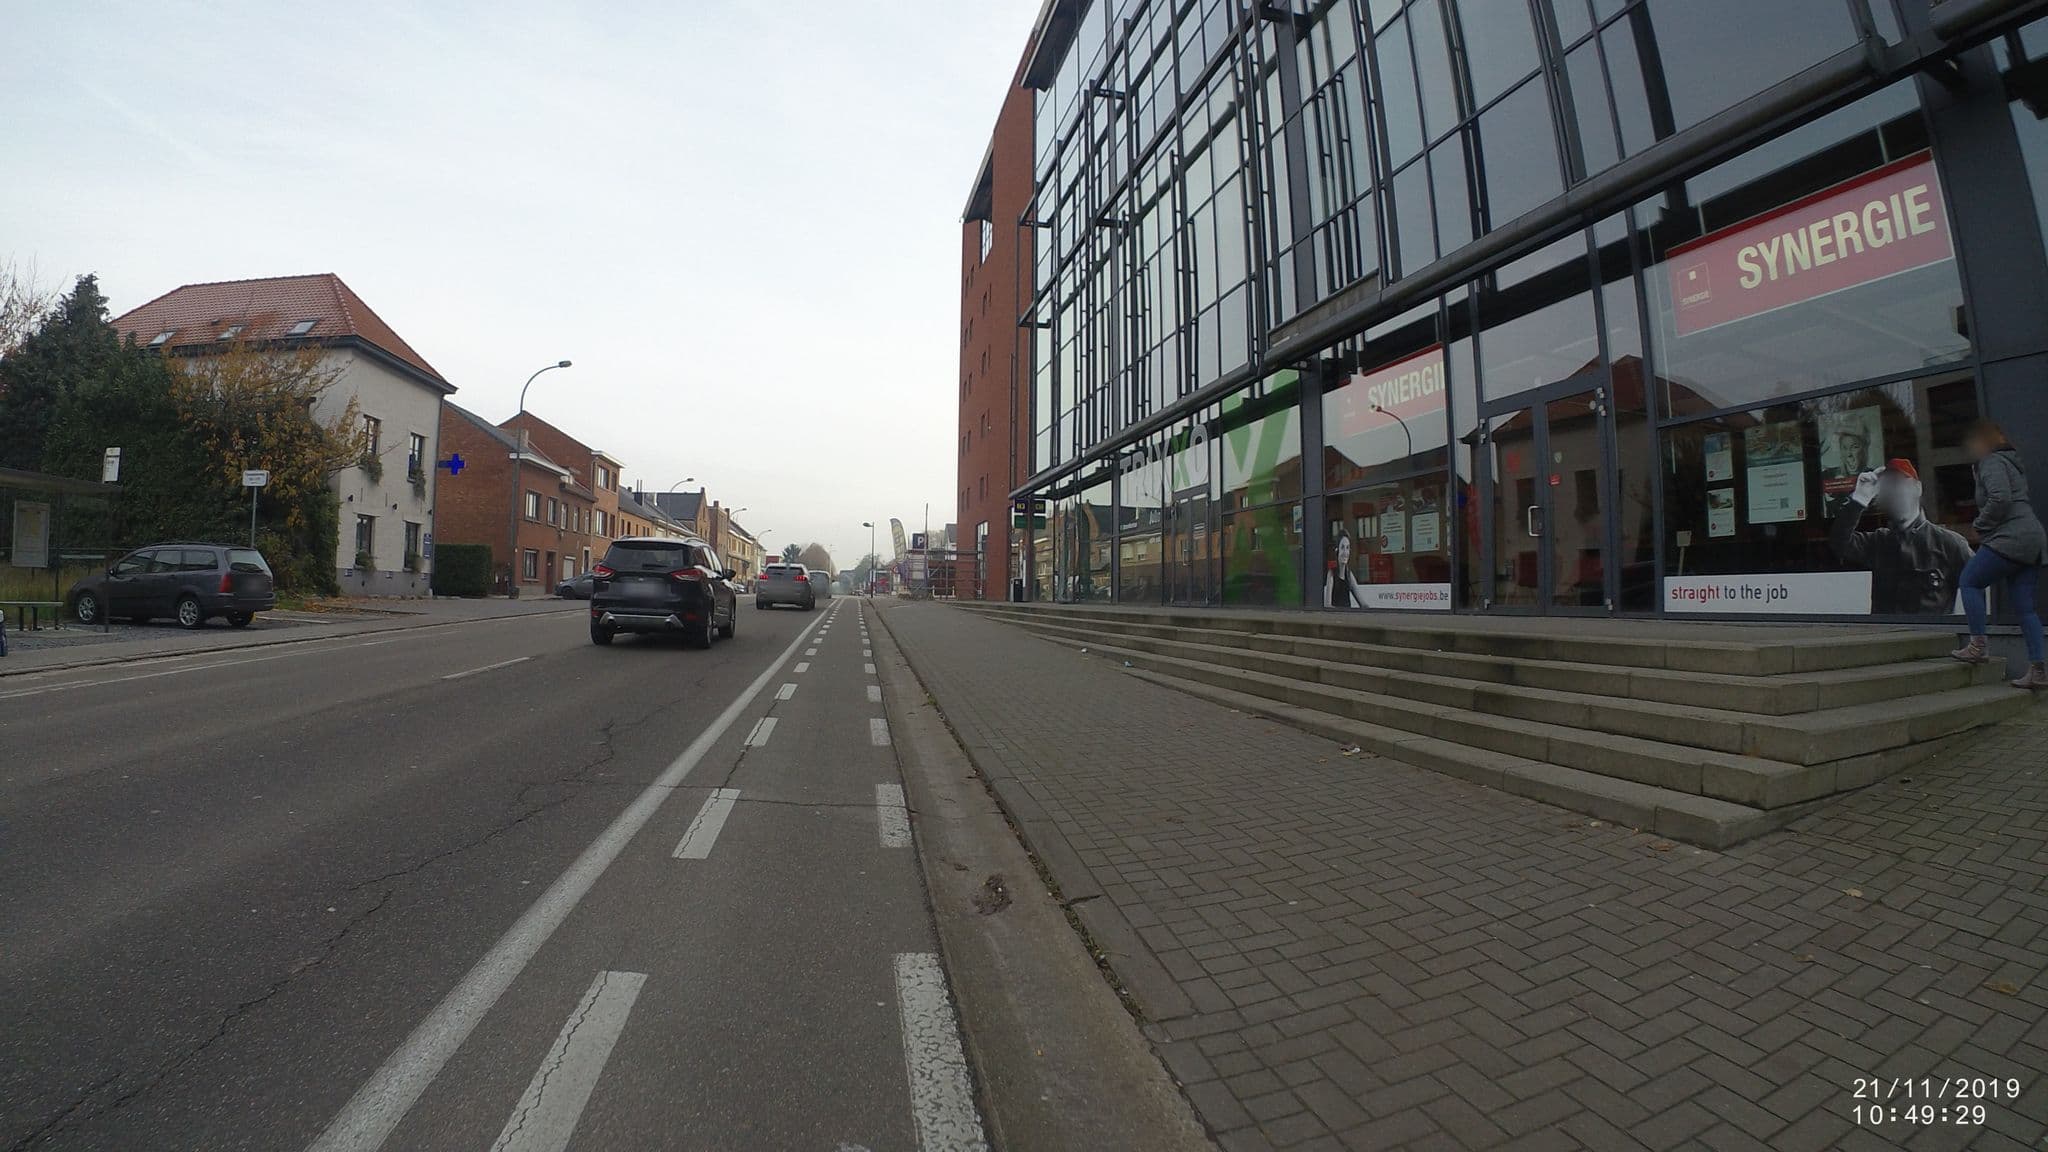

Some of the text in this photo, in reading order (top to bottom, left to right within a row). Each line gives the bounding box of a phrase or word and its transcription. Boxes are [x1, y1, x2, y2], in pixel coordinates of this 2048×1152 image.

[1737, 184, 1936, 290] SYNERGIE
[1378, 590, 1449, 603] www.synergiejobs.be
[1671, 584, 1788, 604] straight to the job
